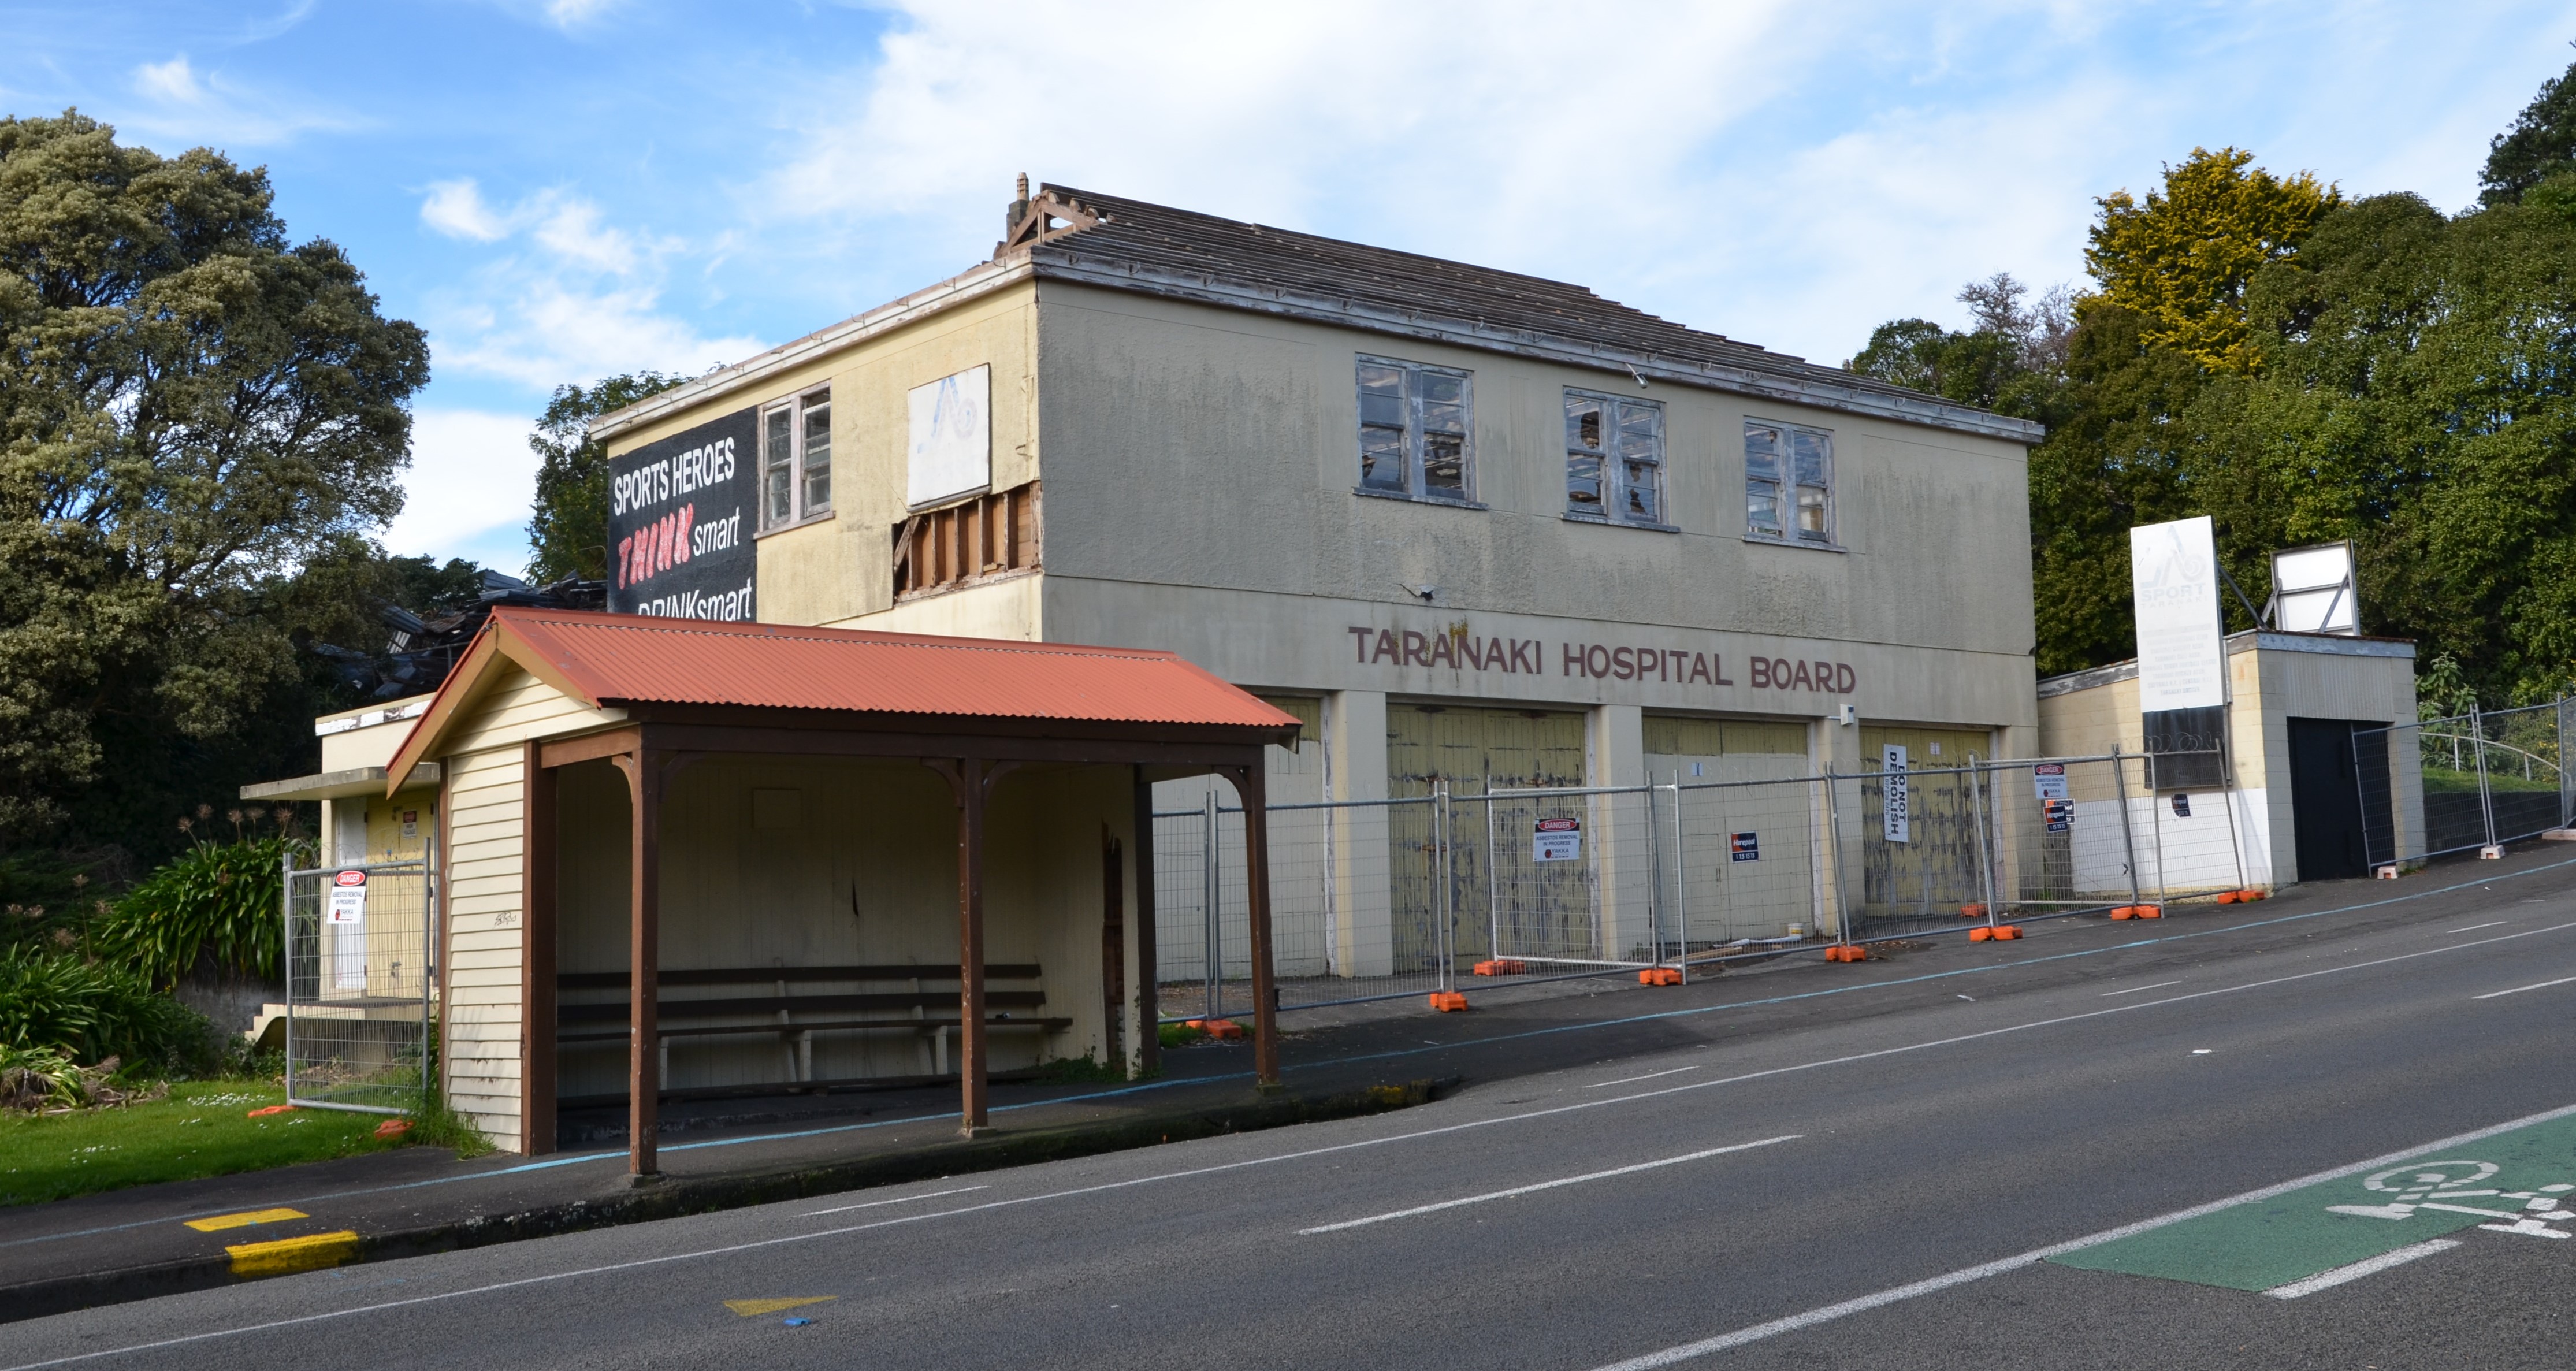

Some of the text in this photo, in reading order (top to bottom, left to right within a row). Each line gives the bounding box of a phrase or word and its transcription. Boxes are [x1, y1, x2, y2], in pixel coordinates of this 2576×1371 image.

[614, 436, 735, 516] SPORTS HEROES
[618, 502, 740, 590] THINK smart
[2141, 582, 2206, 601] SPORT
[2139, 596, 2207, 610] TARANAKI
[1348, 626, 1856, 694] TARANAKI HOSPITAL BOARD
[1890, 752, 1899, 834] DEMOLISH
[1544, 821, 1570, 829] DANGER
[1733, 838, 1755, 846] Hirepool
[340, 874, 360, 883] DANGER
